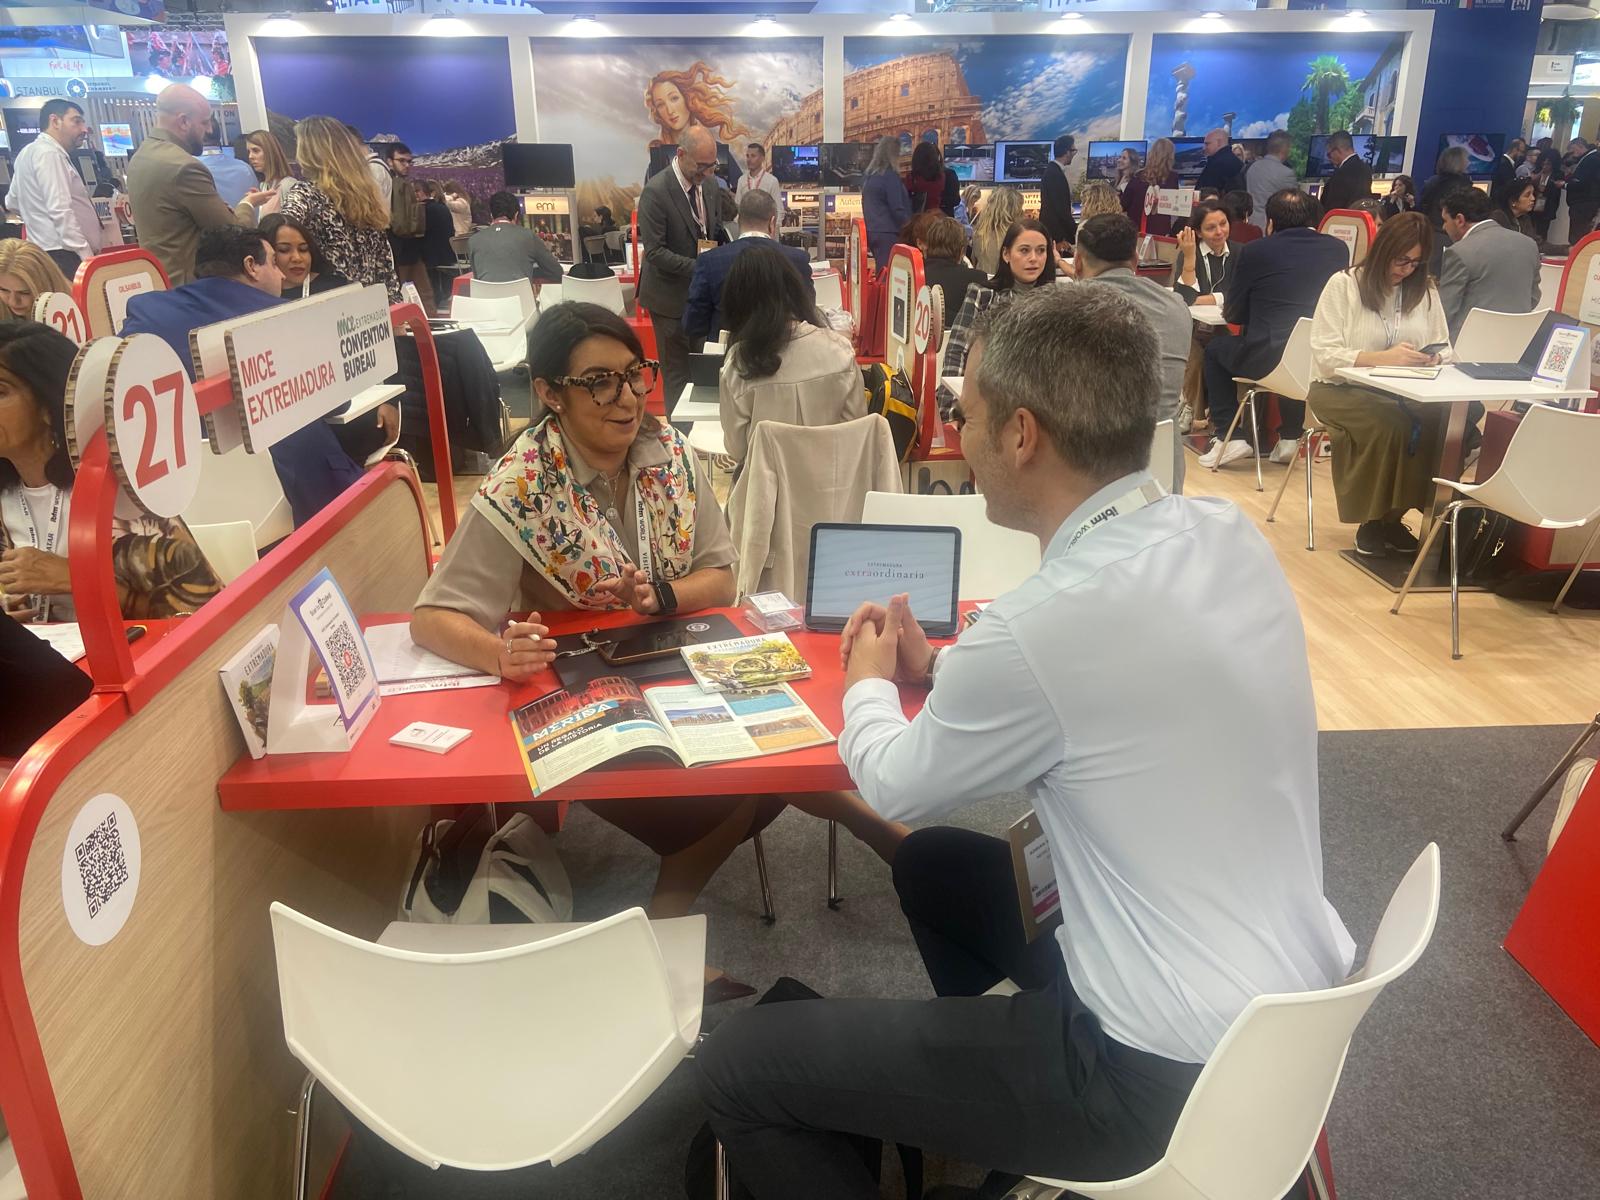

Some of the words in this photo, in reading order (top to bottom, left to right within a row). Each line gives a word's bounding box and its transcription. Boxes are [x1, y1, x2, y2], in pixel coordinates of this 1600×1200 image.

[52, 307, 82, 344] 21
[915, 301, 930, 341] 20
[339, 320, 391, 359] CONVENTION
[240, 350, 277, 389] MICE
[343, 348, 377, 383] BUREAU
[247, 360, 336, 425] EXTREMADURA
[123, 370, 187, 489] 27
[1090, 505, 1119, 526] ibtm
[844, 568, 925, 580] extraordinaria
[243, 641, 275, 677] EXTREMADURA
[706, 636, 768, 651] EXTREMADURA
[551, 726, 585, 745] REGALO
[552, 740, 563, 749] LA
[563, 723, 603, 746] HISTORIA
